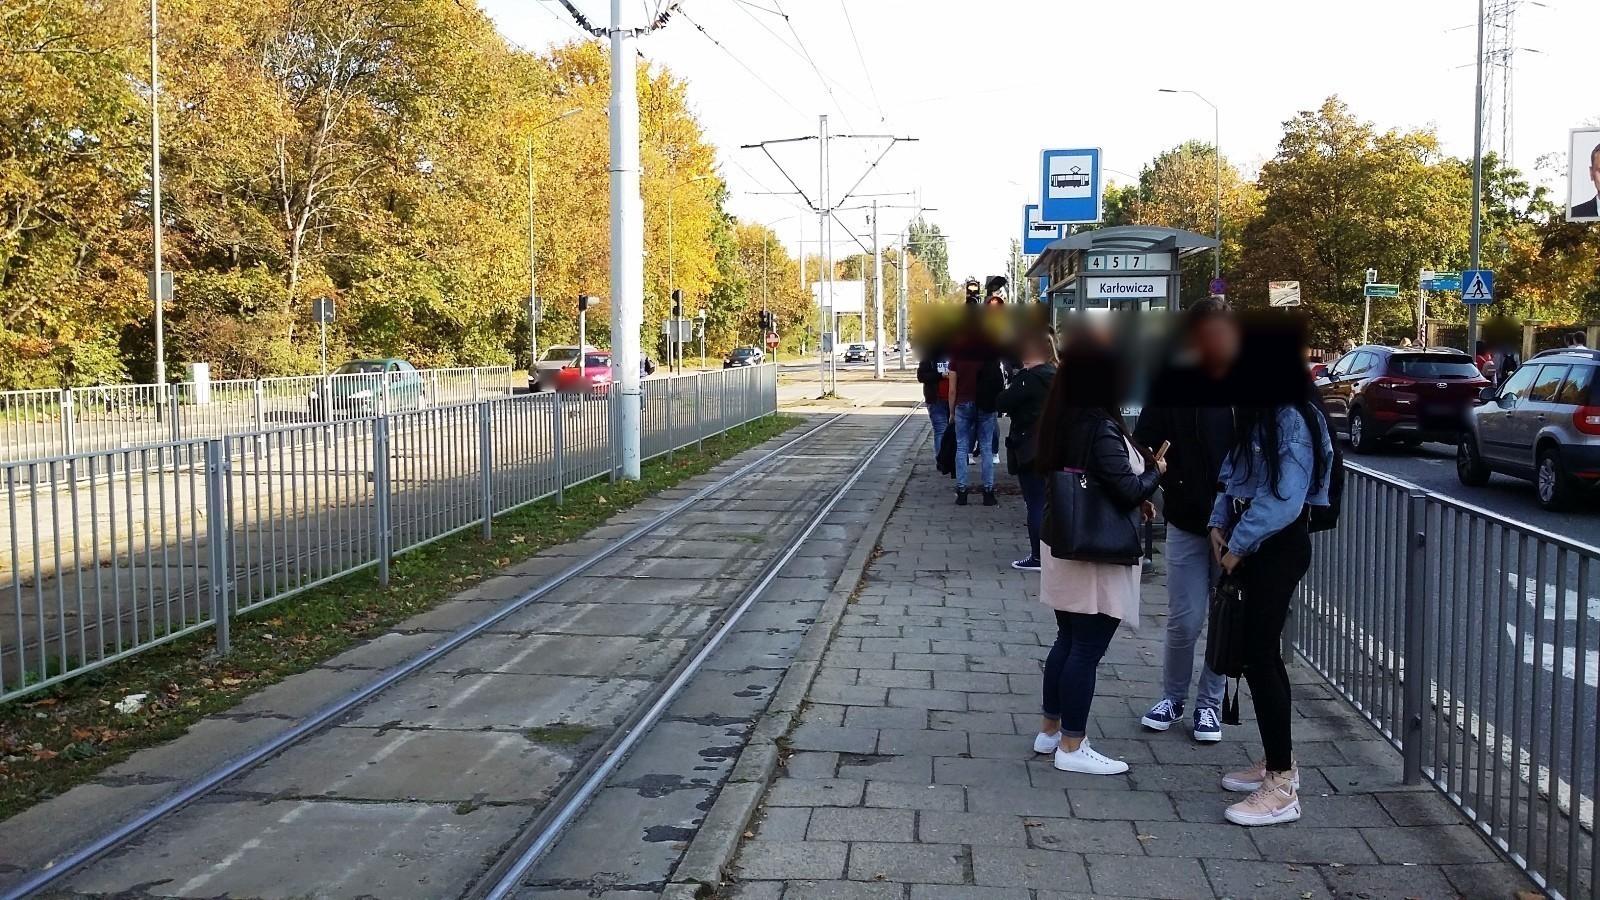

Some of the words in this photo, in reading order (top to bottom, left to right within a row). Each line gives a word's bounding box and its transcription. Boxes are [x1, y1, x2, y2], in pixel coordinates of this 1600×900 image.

[1093, 257, 1100, 268] 4
[1112, 256, 1119, 268] 5
[1133, 256, 1140, 268] 7
[1099, 282, 1154, 294] Karłowicza
